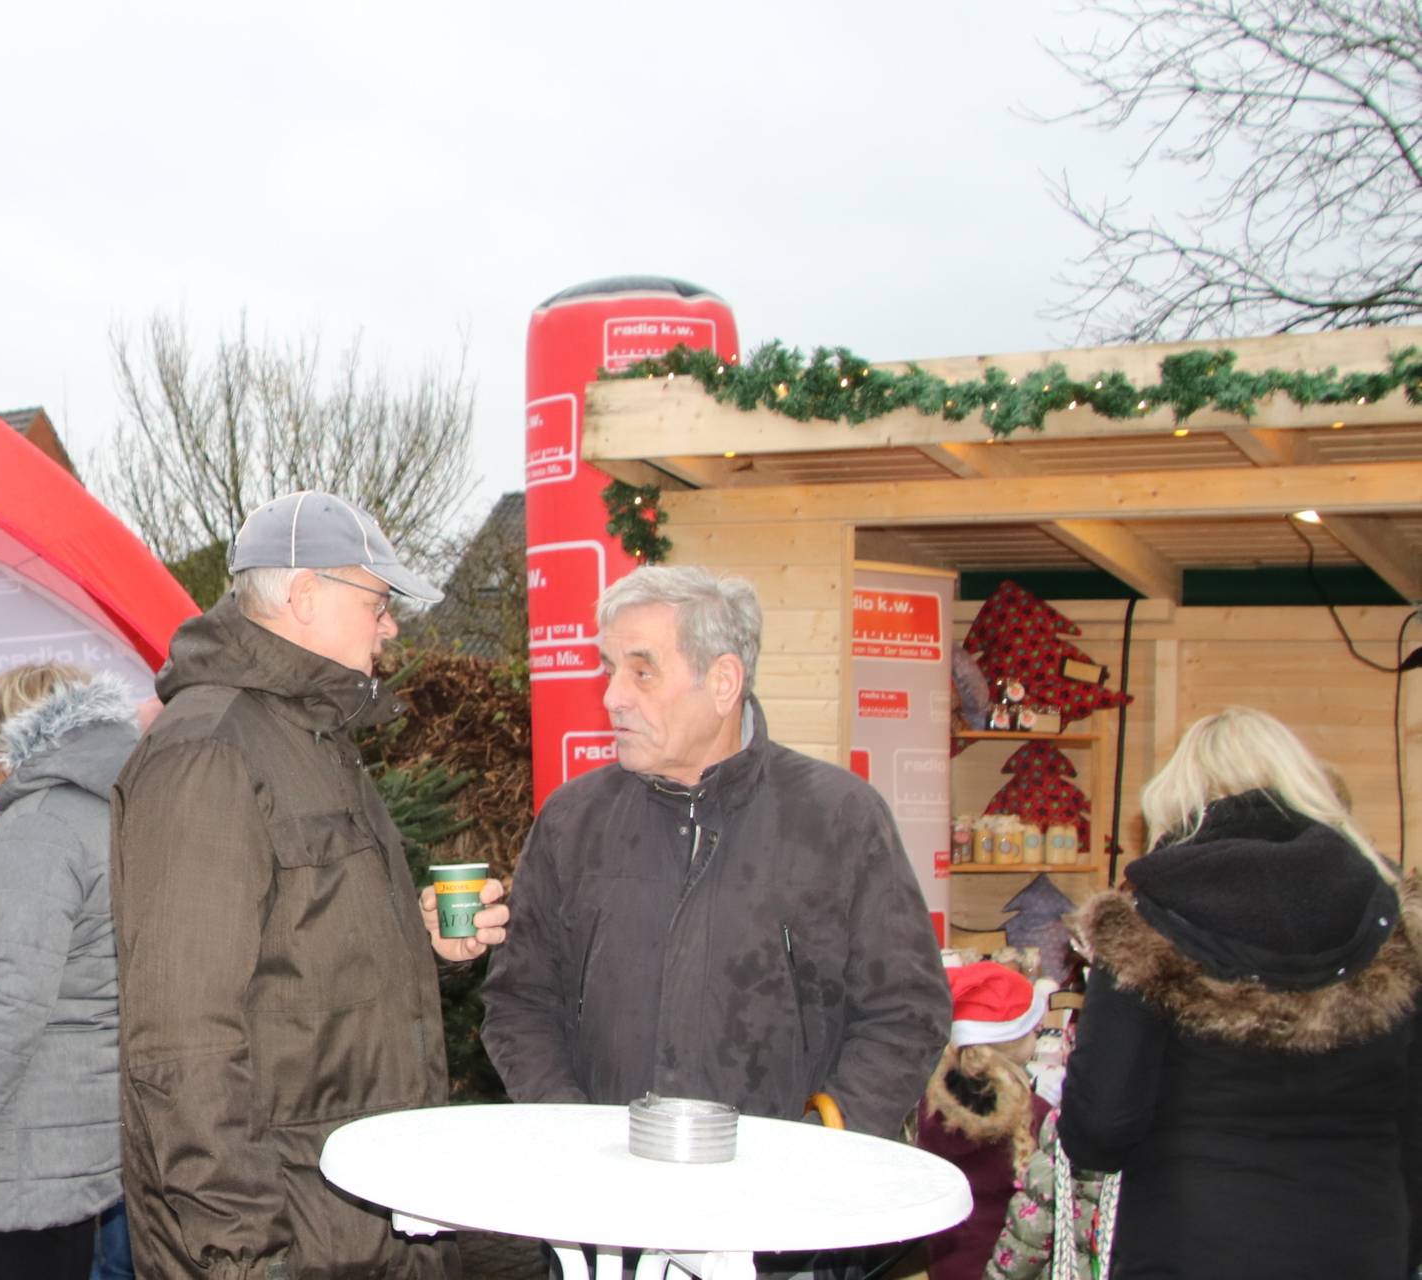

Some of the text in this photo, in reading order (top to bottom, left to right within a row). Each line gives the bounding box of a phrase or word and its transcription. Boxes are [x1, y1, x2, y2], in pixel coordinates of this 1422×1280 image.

[613, 322, 694, 336] radio k.w.
[853, 594, 914, 614] dio k.w.
[556, 651, 584, 667] Mix.
[574, 740, 617, 760] rad
[441, 909, 475, 927] Aro
